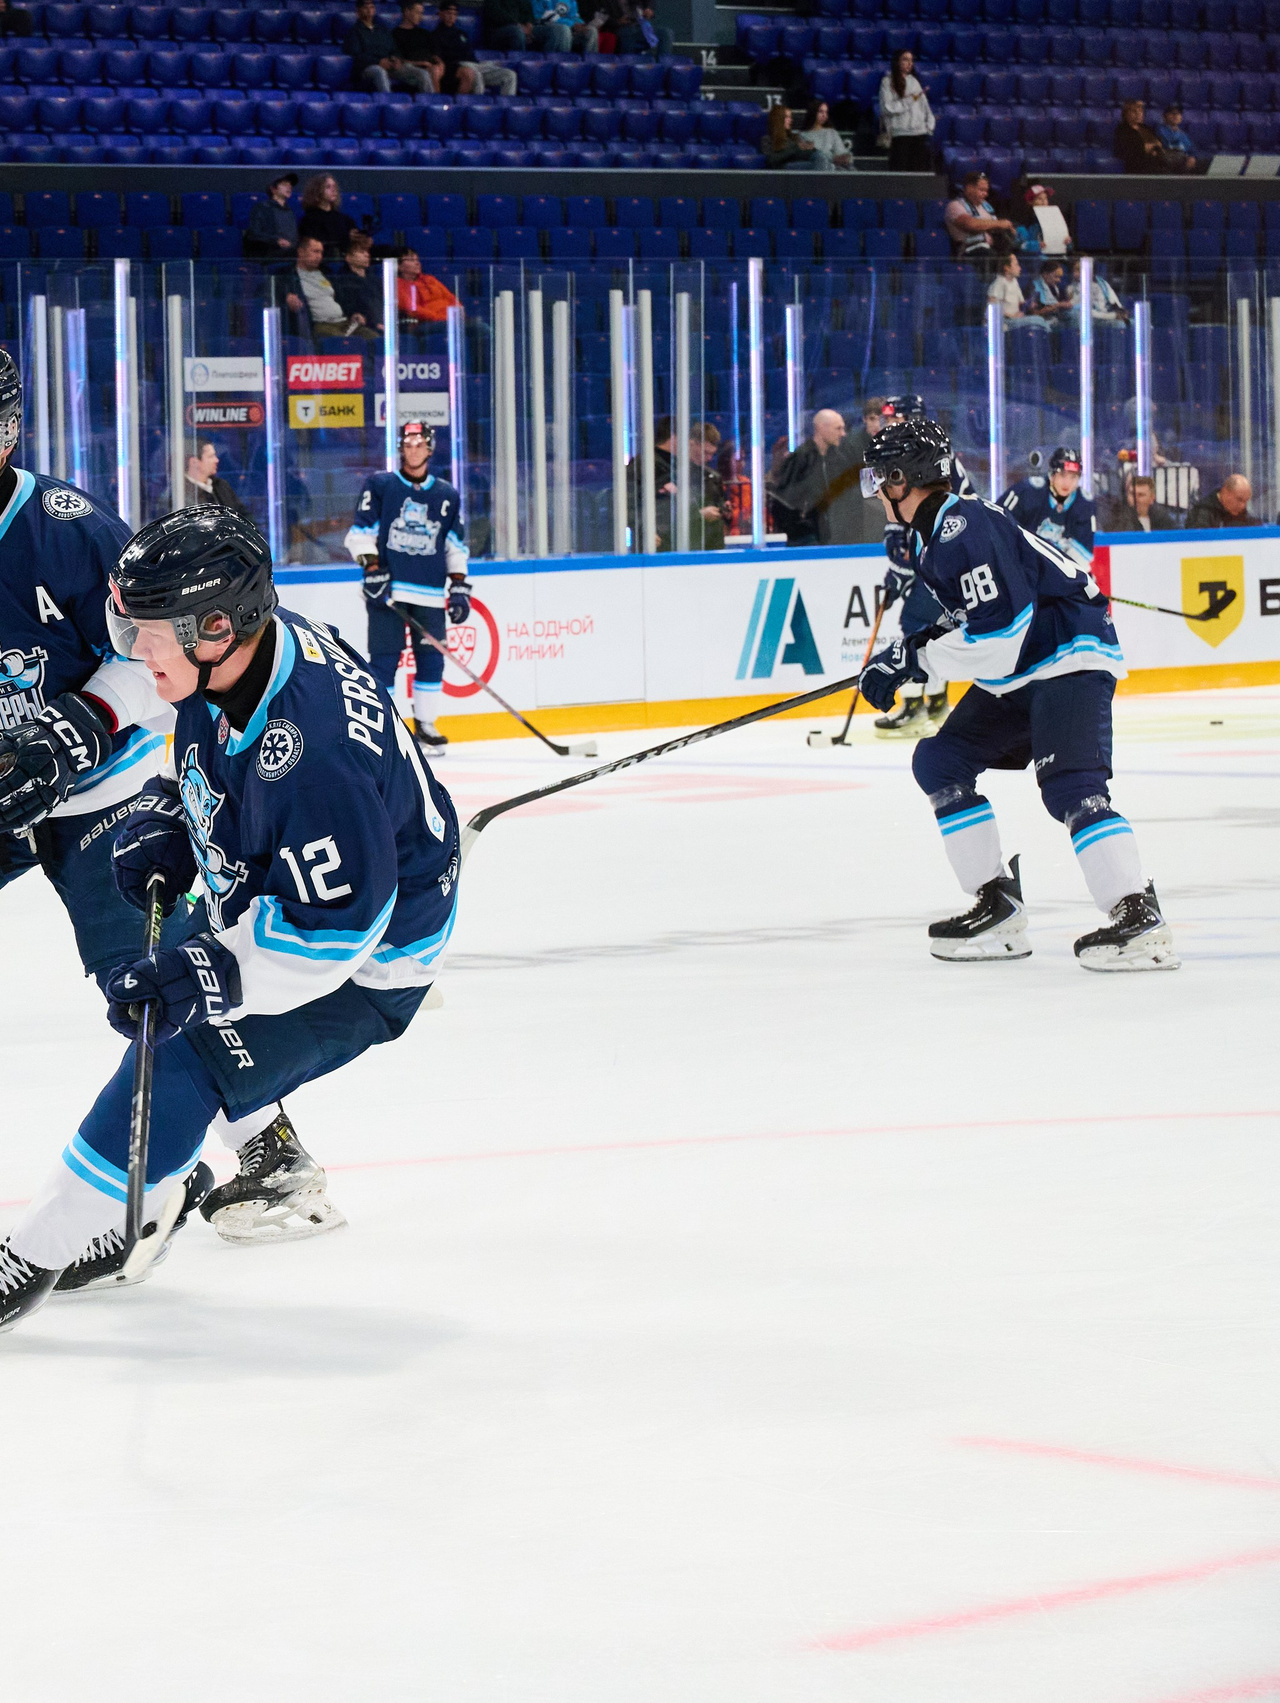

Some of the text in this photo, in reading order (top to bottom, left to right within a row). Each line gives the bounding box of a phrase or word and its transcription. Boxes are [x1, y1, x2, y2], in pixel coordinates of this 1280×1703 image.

[289, 362, 360, 382] FONBET
[194, 408, 248, 422] WINLINE
[319, 405, 355, 416] БАНК
[181, 577, 221, 596] BAUER
[960, 563, 999, 610] 98
[35, 586, 65, 624] A
[507, 615, 594, 638] НА ОДНОЙ
[507, 643, 564, 662] ЛИНИИ
[37, 705, 92, 772] CCM
[279, 834, 353, 904] 12
